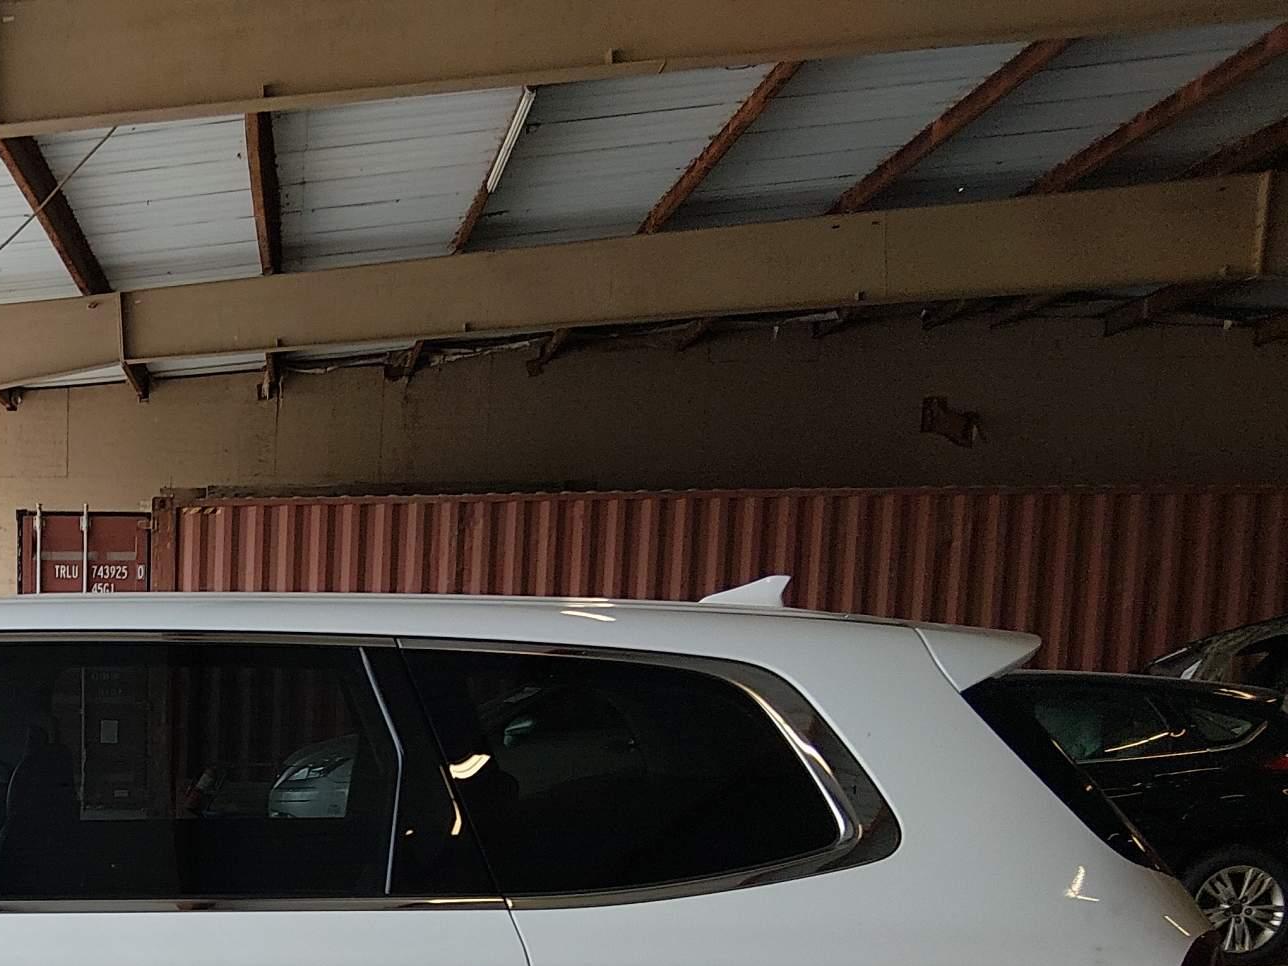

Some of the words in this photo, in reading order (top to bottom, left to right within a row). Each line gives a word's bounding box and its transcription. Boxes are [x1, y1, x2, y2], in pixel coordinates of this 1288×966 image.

[54, 564, 79, 579] TRLU
[91, 564, 128, 580] 743925
[136, 564, 145, 580] 0
